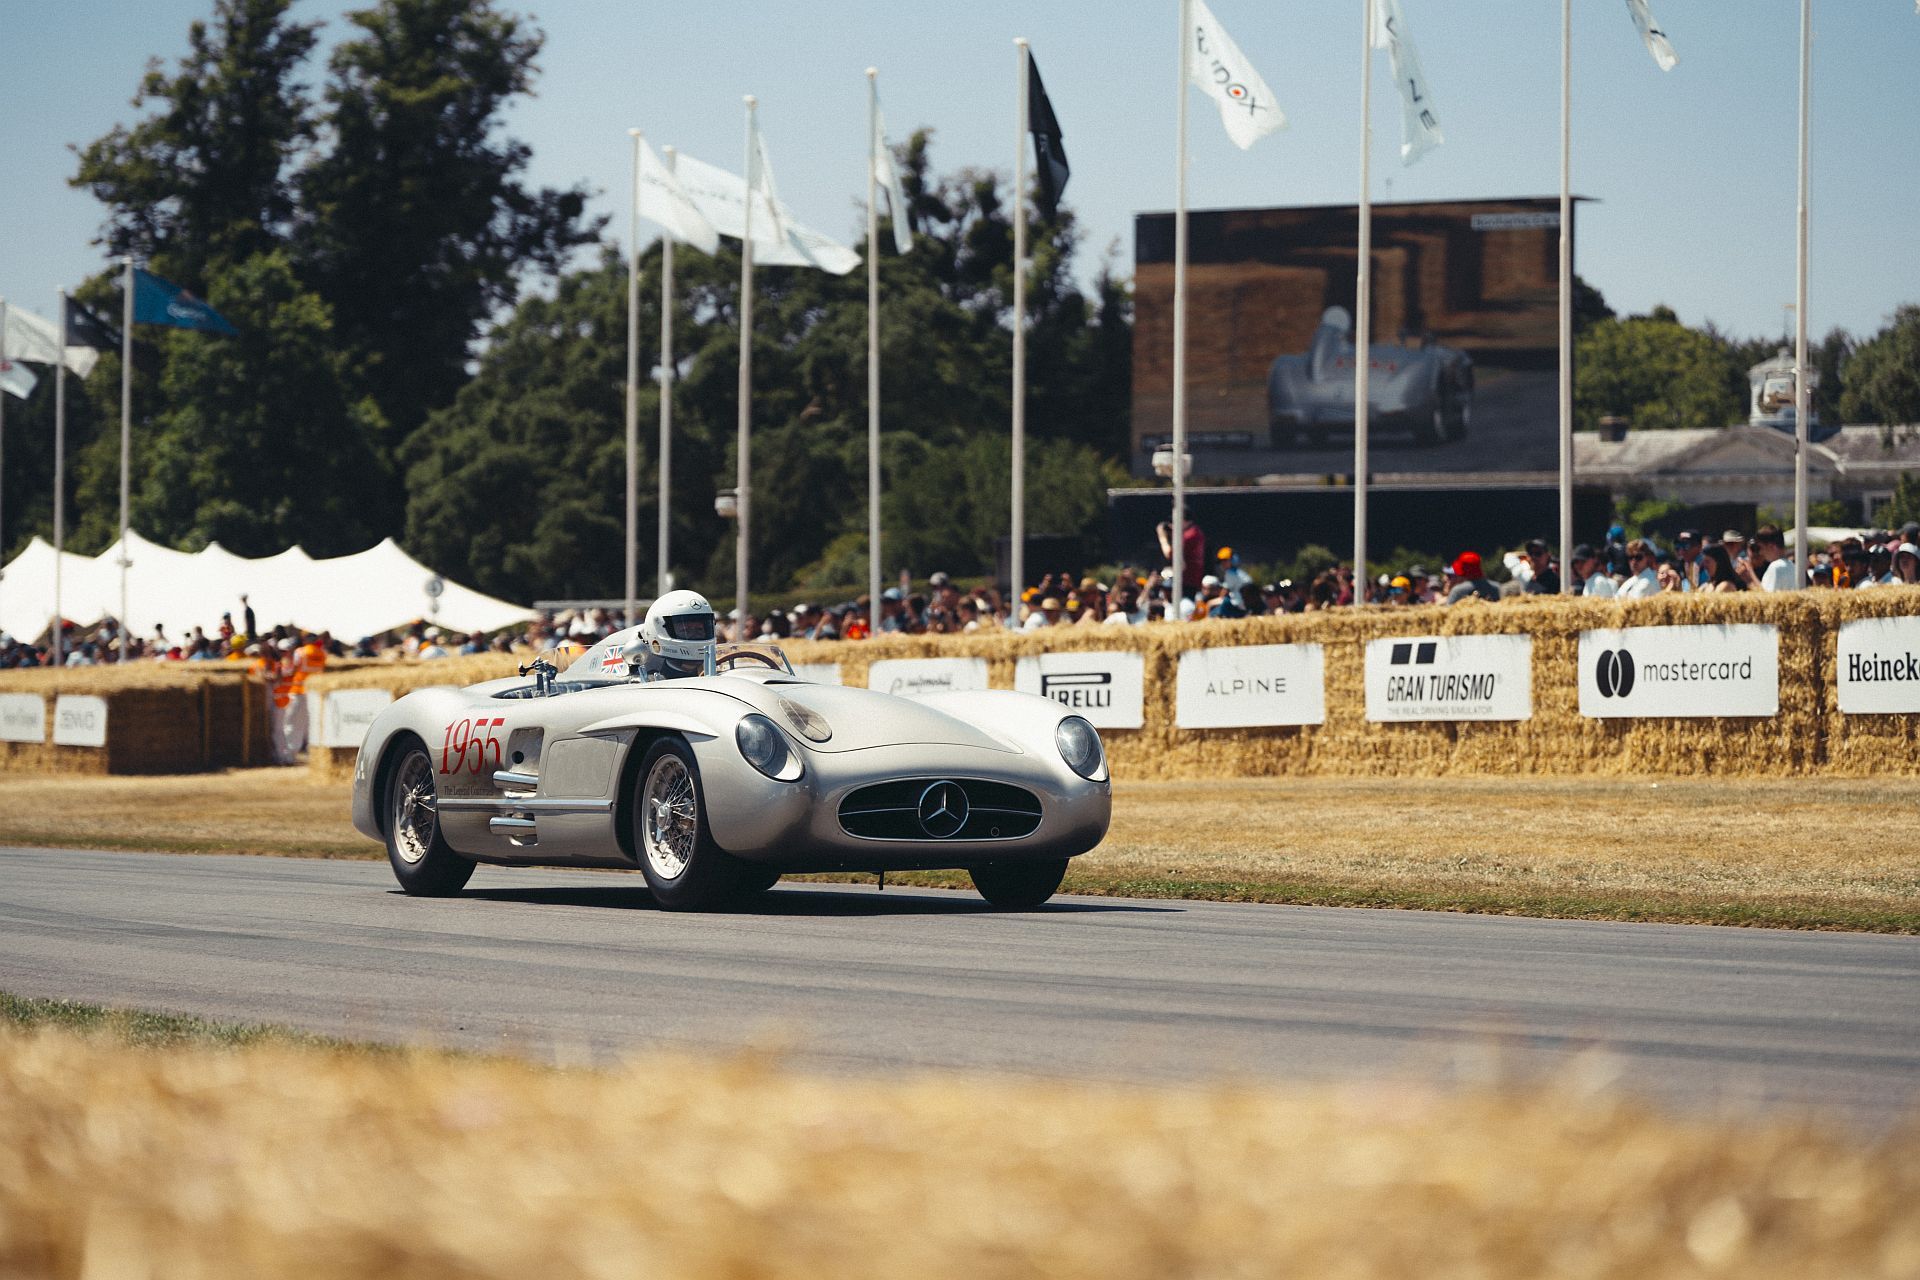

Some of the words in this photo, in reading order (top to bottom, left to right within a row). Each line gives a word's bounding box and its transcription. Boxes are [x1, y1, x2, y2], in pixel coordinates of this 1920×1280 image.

[1643, 656, 1752, 683] mastercard
[1848, 652, 1920, 682] Heinek
[1205, 677, 1288, 695] ALPINE
[1387, 675, 1425, 701] GRAN
[439, 717, 505, 775] 1955
